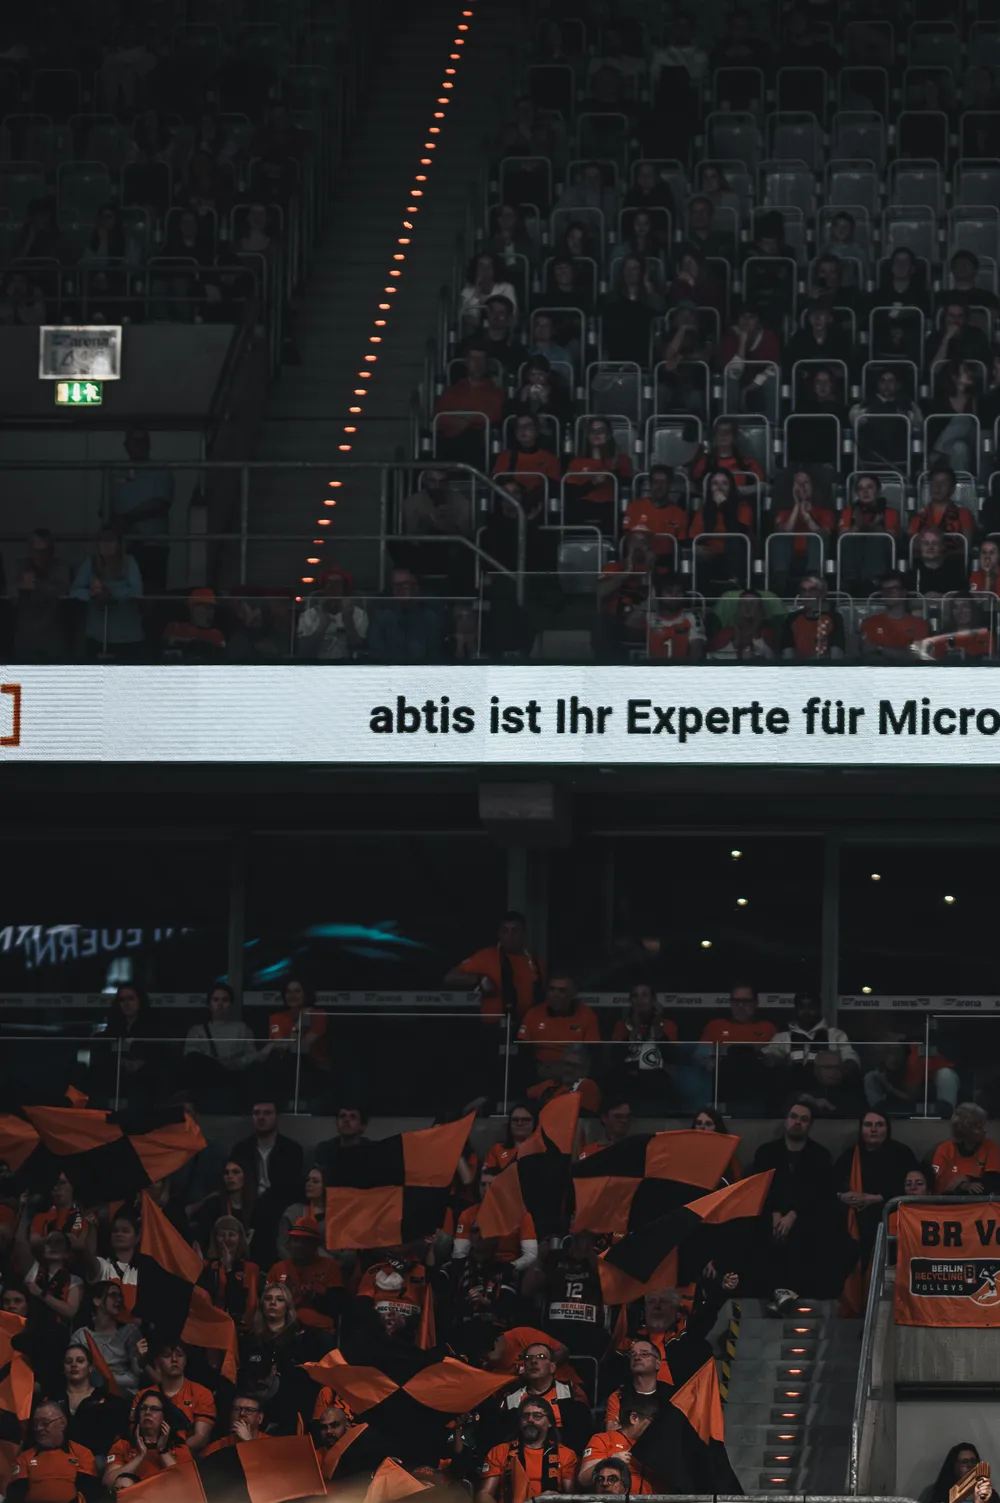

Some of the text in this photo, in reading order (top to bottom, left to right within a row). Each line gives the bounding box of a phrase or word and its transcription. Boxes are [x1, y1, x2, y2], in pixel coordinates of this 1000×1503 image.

[370, 697, 474, 733] abtis
[491, 697, 541, 733] ist
[557, 697, 612, 733] Ihr
[628, 700, 789, 743] Experte
[802, 697, 865, 734] für
[921, 1221, 962, 1247] BR
[931, 1264, 963, 1272] BERLIN
[565, 1282, 584, 1299] 12
